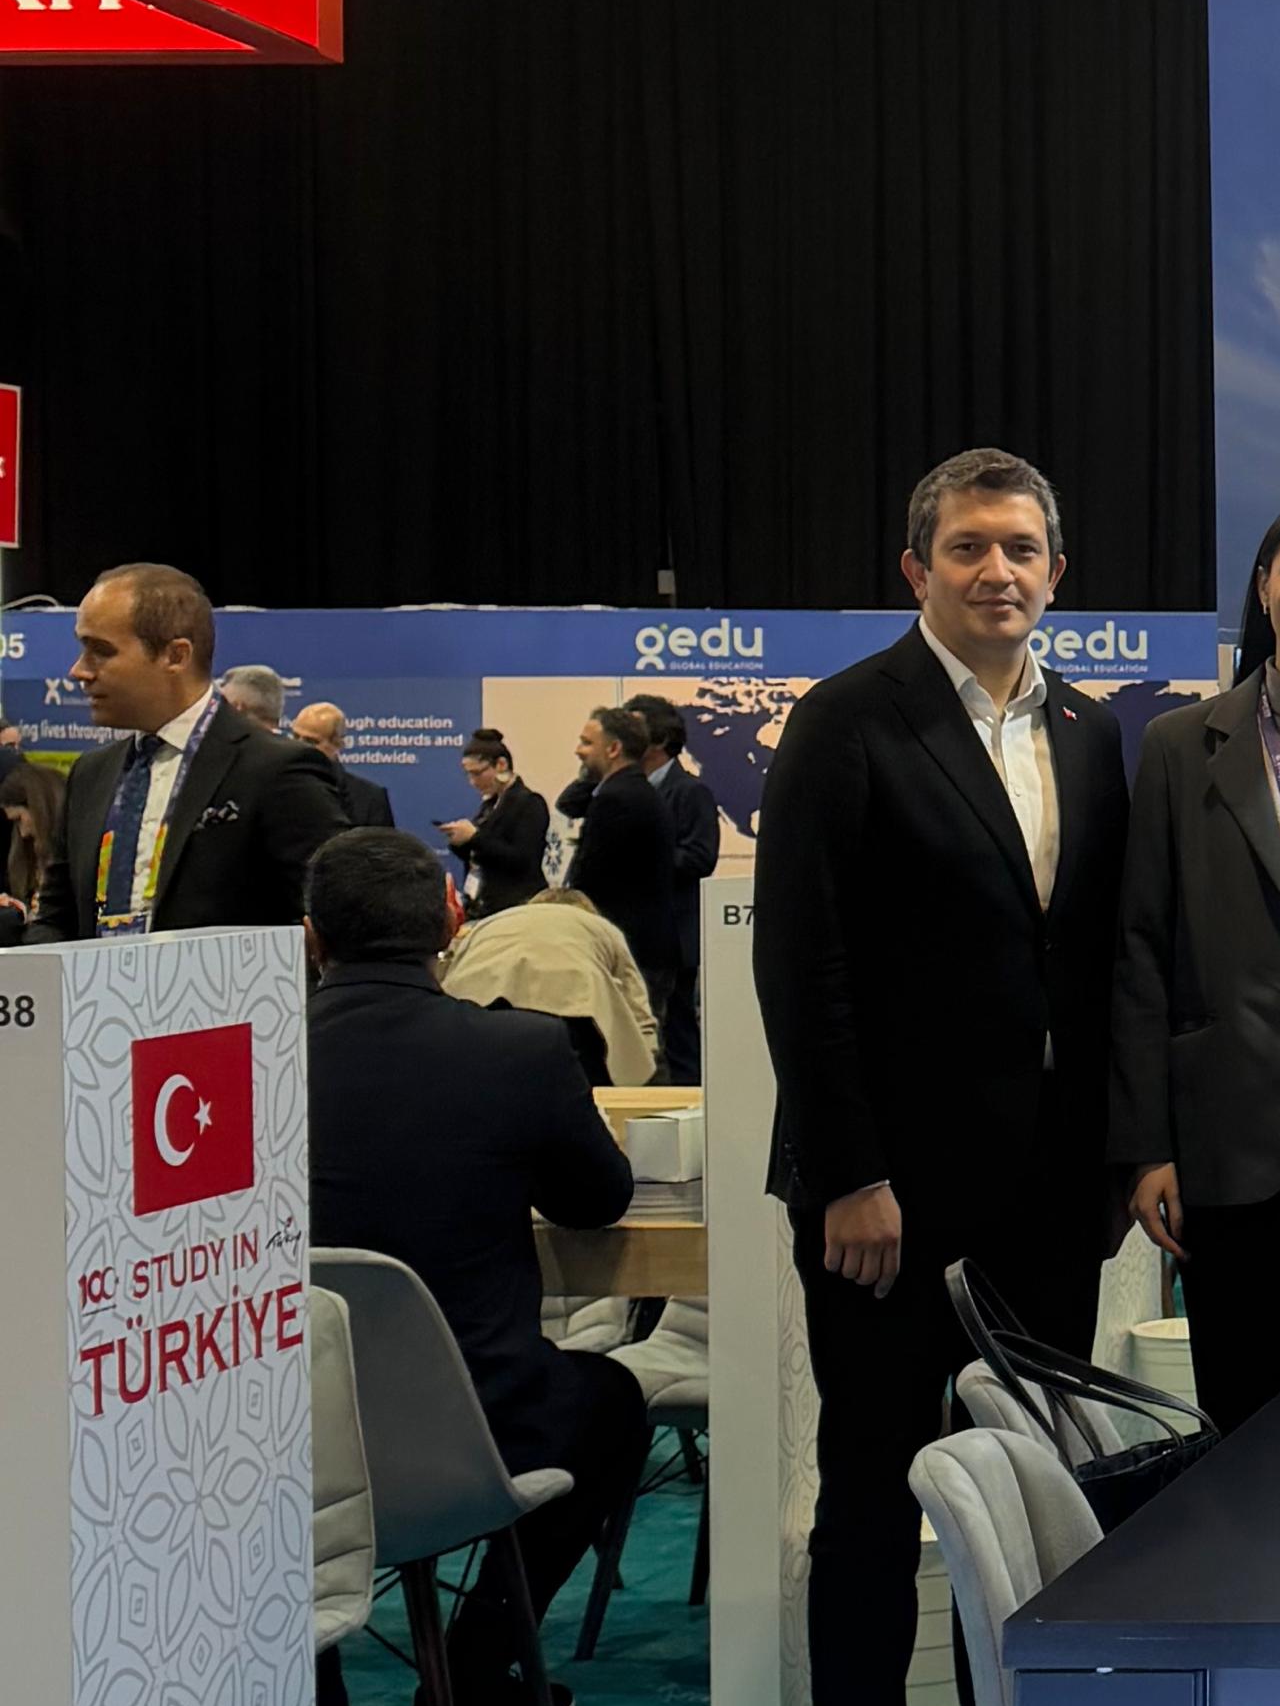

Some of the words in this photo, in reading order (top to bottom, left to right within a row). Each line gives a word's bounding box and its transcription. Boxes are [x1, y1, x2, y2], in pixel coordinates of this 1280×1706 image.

[635, 618, 763, 670] gedu
[358, 733, 431, 747] standards
[434, 733, 463, 747] and
[378, 715, 453, 729] education
[133, 1237, 226, 1300] STUDY
[232, 1228, 259, 1271] IN
[80, 1281, 304, 1418] TÜRKİYE
